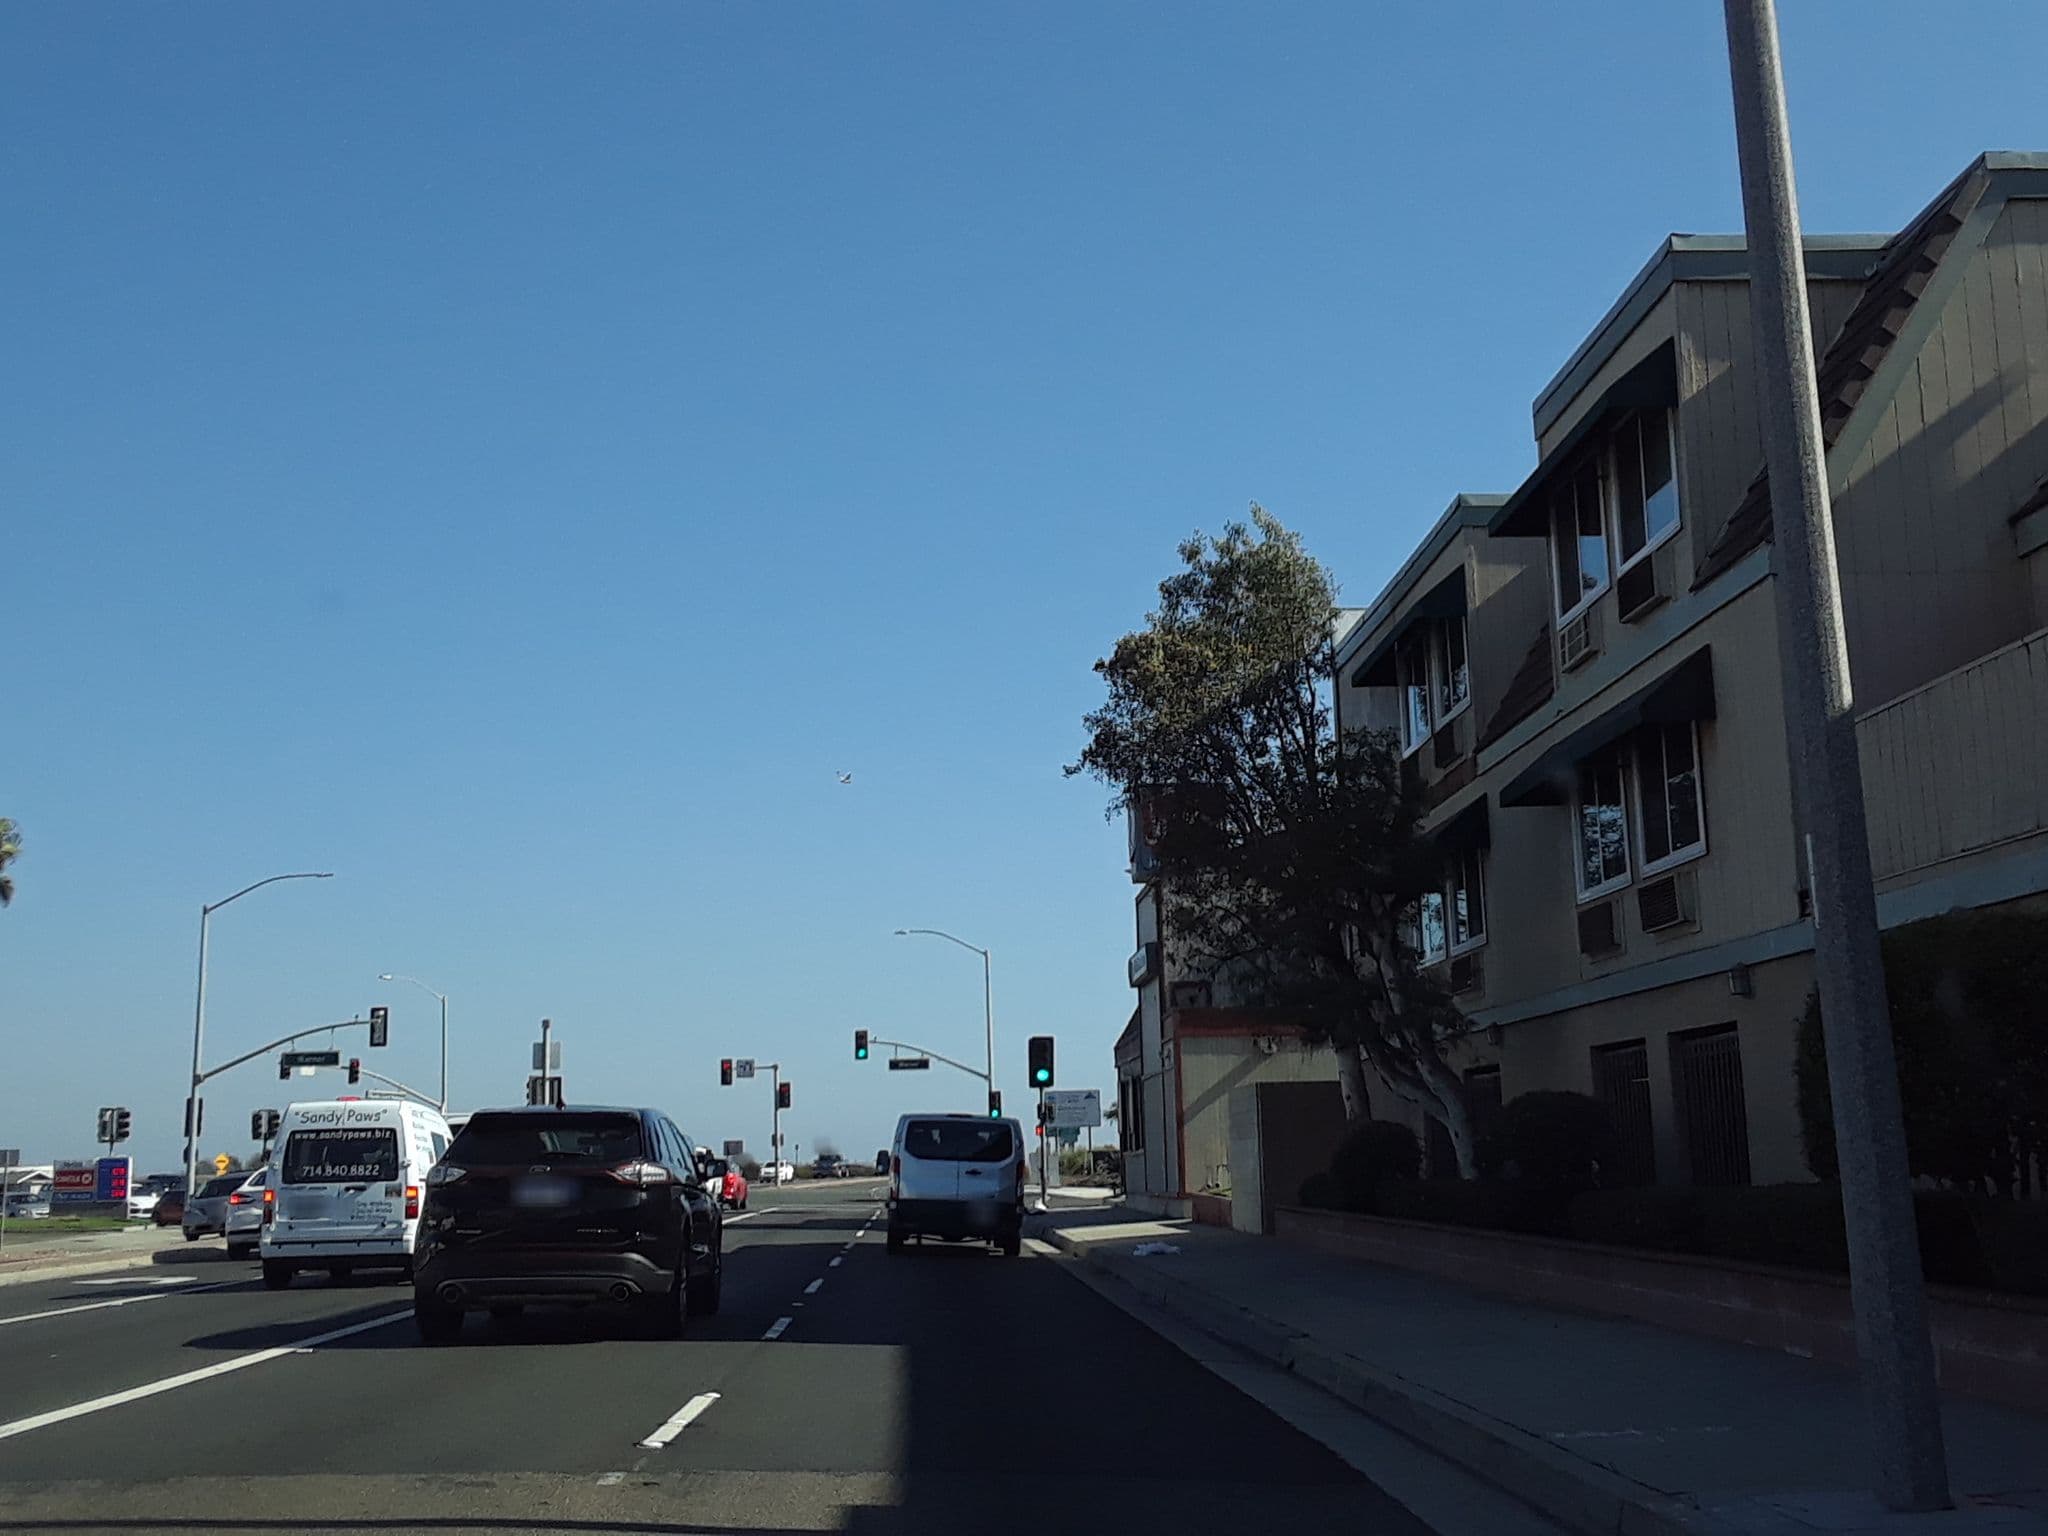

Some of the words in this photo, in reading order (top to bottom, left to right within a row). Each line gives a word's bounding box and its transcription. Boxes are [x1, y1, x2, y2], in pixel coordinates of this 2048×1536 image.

[295, 1111, 342, 1126] "Sandy
[347, 1109, 388, 1121] Paws"
[294, 1130, 391, 1140] www.sandypaws.biz
